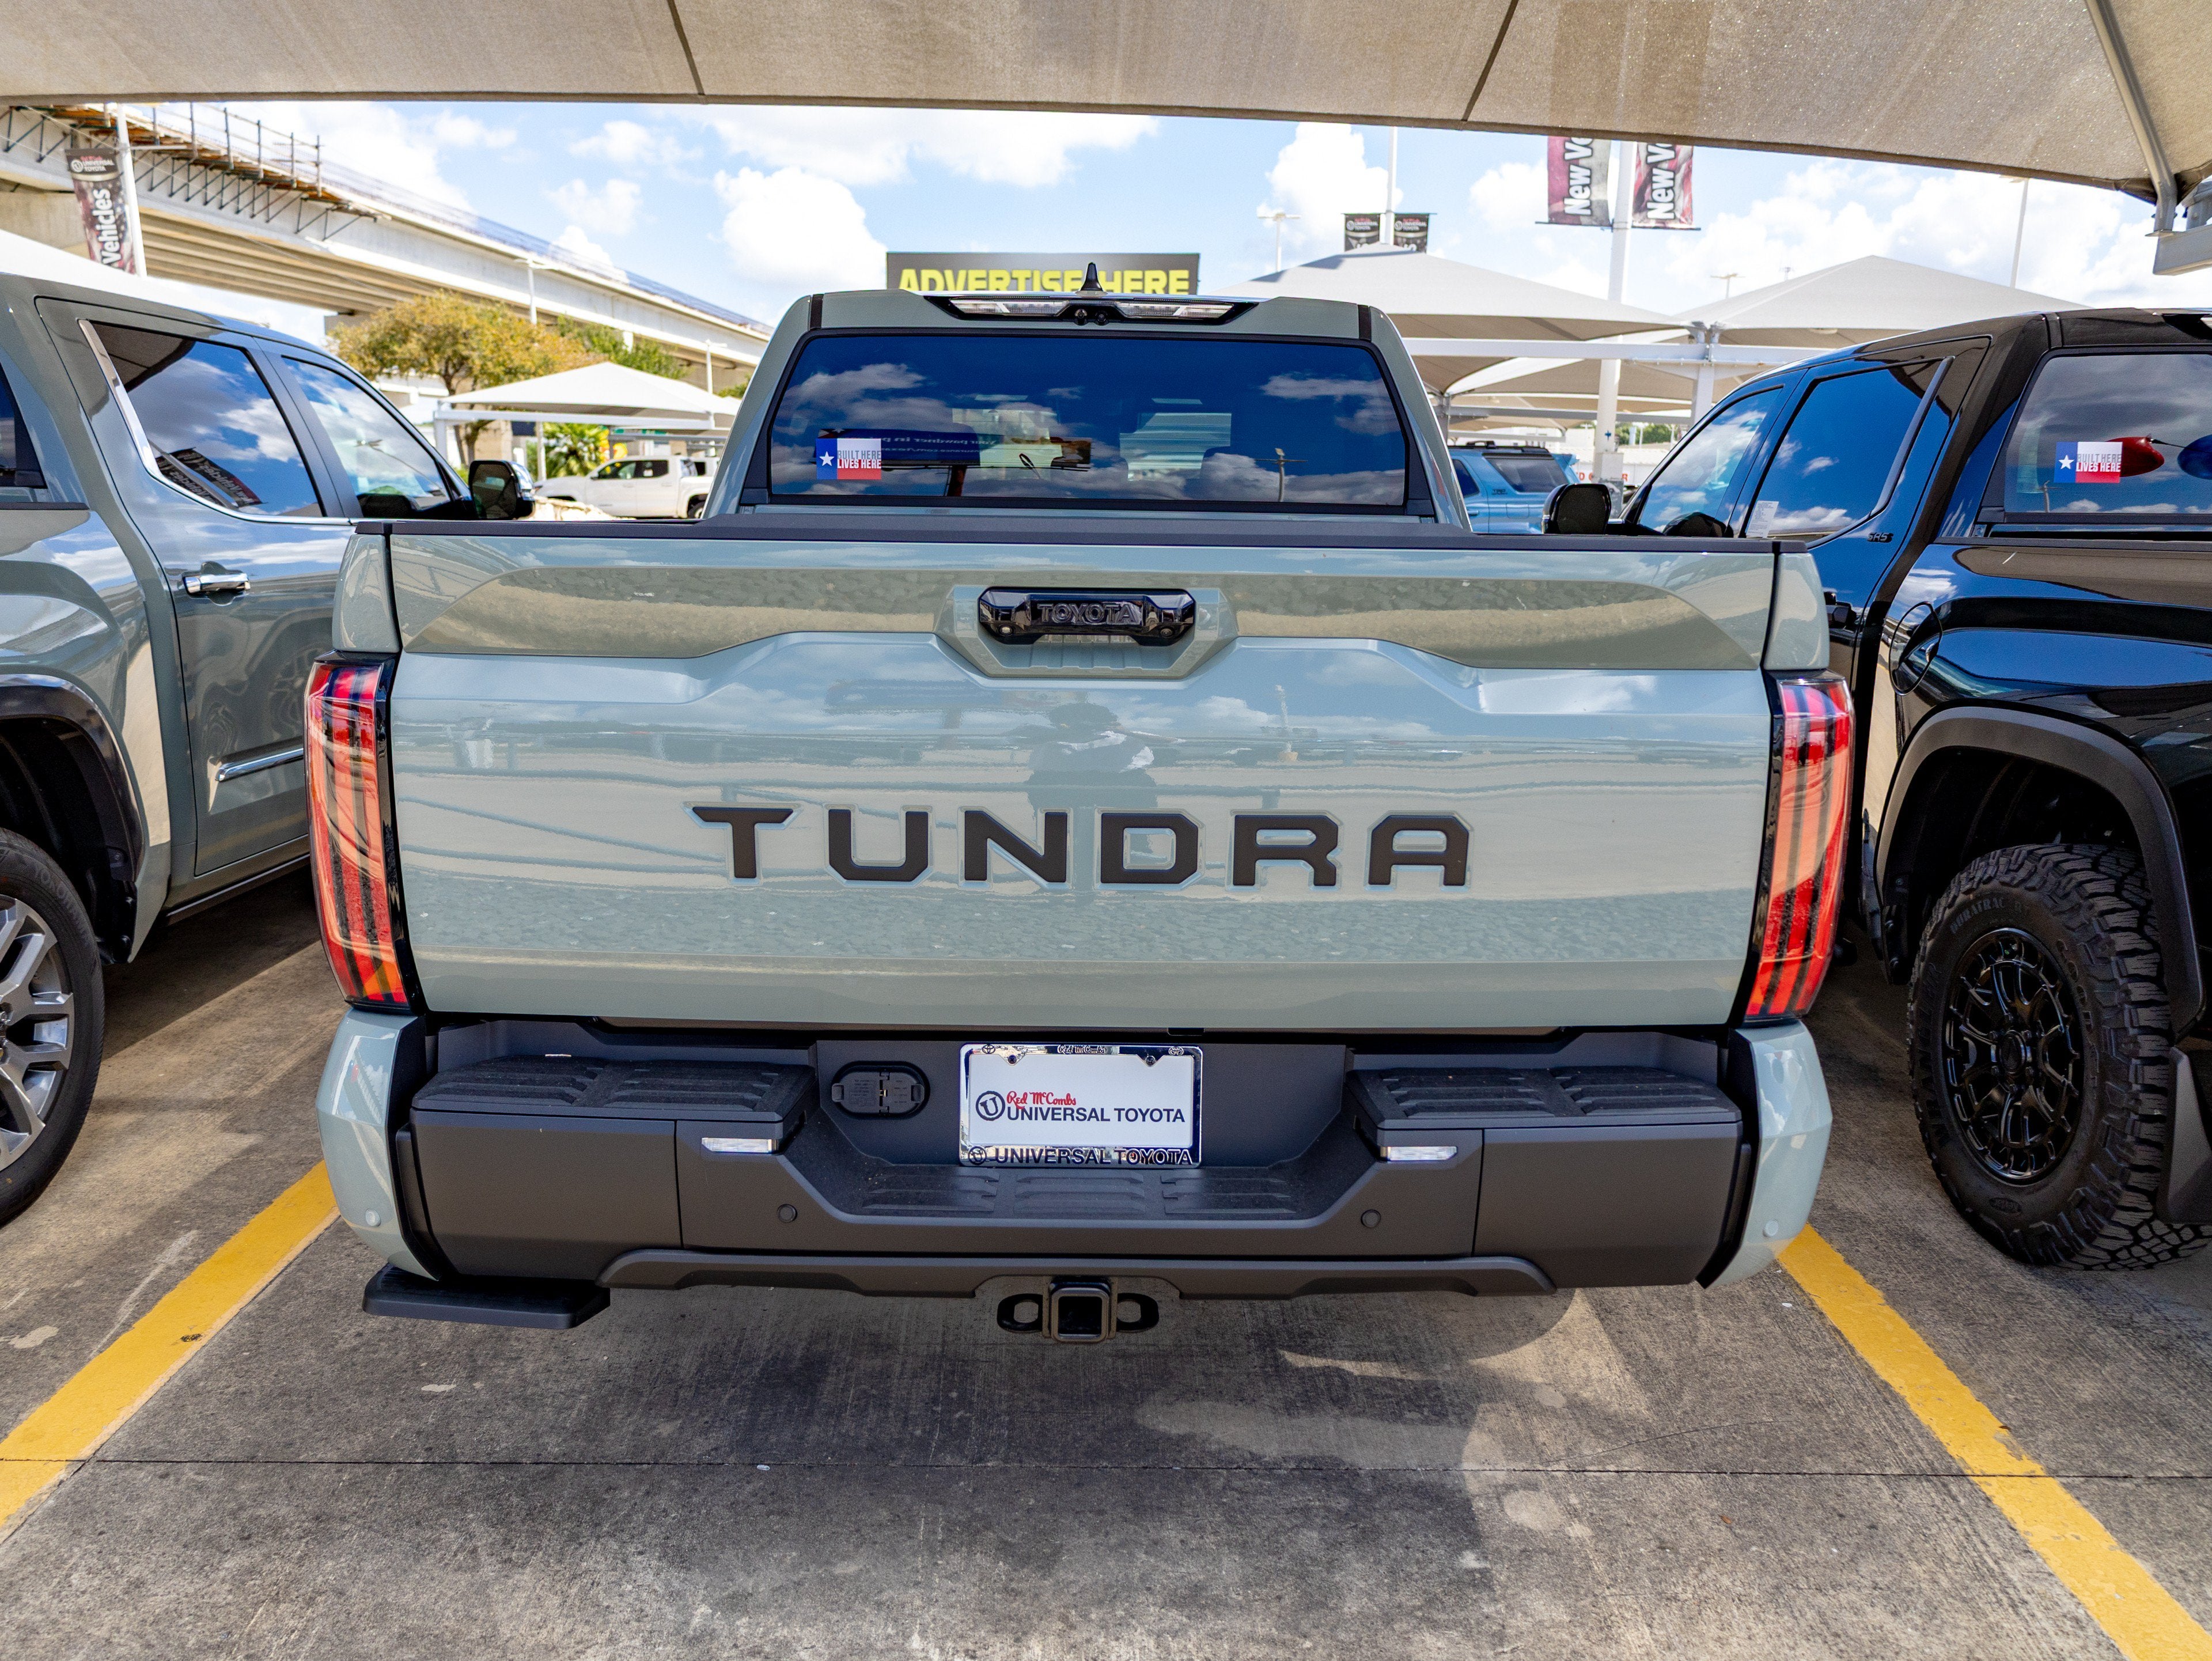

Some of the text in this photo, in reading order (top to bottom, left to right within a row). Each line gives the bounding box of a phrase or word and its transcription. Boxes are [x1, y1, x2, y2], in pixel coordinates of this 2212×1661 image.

[1564, 165, 1592, 216] New
[1647, 168, 1675, 219] New
[92, 188, 122, 265] Vehicles
[899, 269, 1190, 296] ADVERTISE HERE
[837, 459, 881, 468] LIVES HERE
[838, 450, 881, 459] BUILT HERE
[2077, 453, 2122, 463] BUILT HERE
[2076, 461, 2121, 472] LIVES HERE
[1037, 603, 1139, 623] TOYOTA
[688, 804, 1474, 889] TUNDRA
[1949, 897, 2005, 934] DURATRAC
[1057, 1044, 1074, 1054] Red
[1007, 1091, 1077, 1109] Red McCombs
[1007, 1107, 1185, 1123] UNIVERSAL TOYOTA
[995, 1148, 1193, 1166] UNIVERSAL TOYOTA
